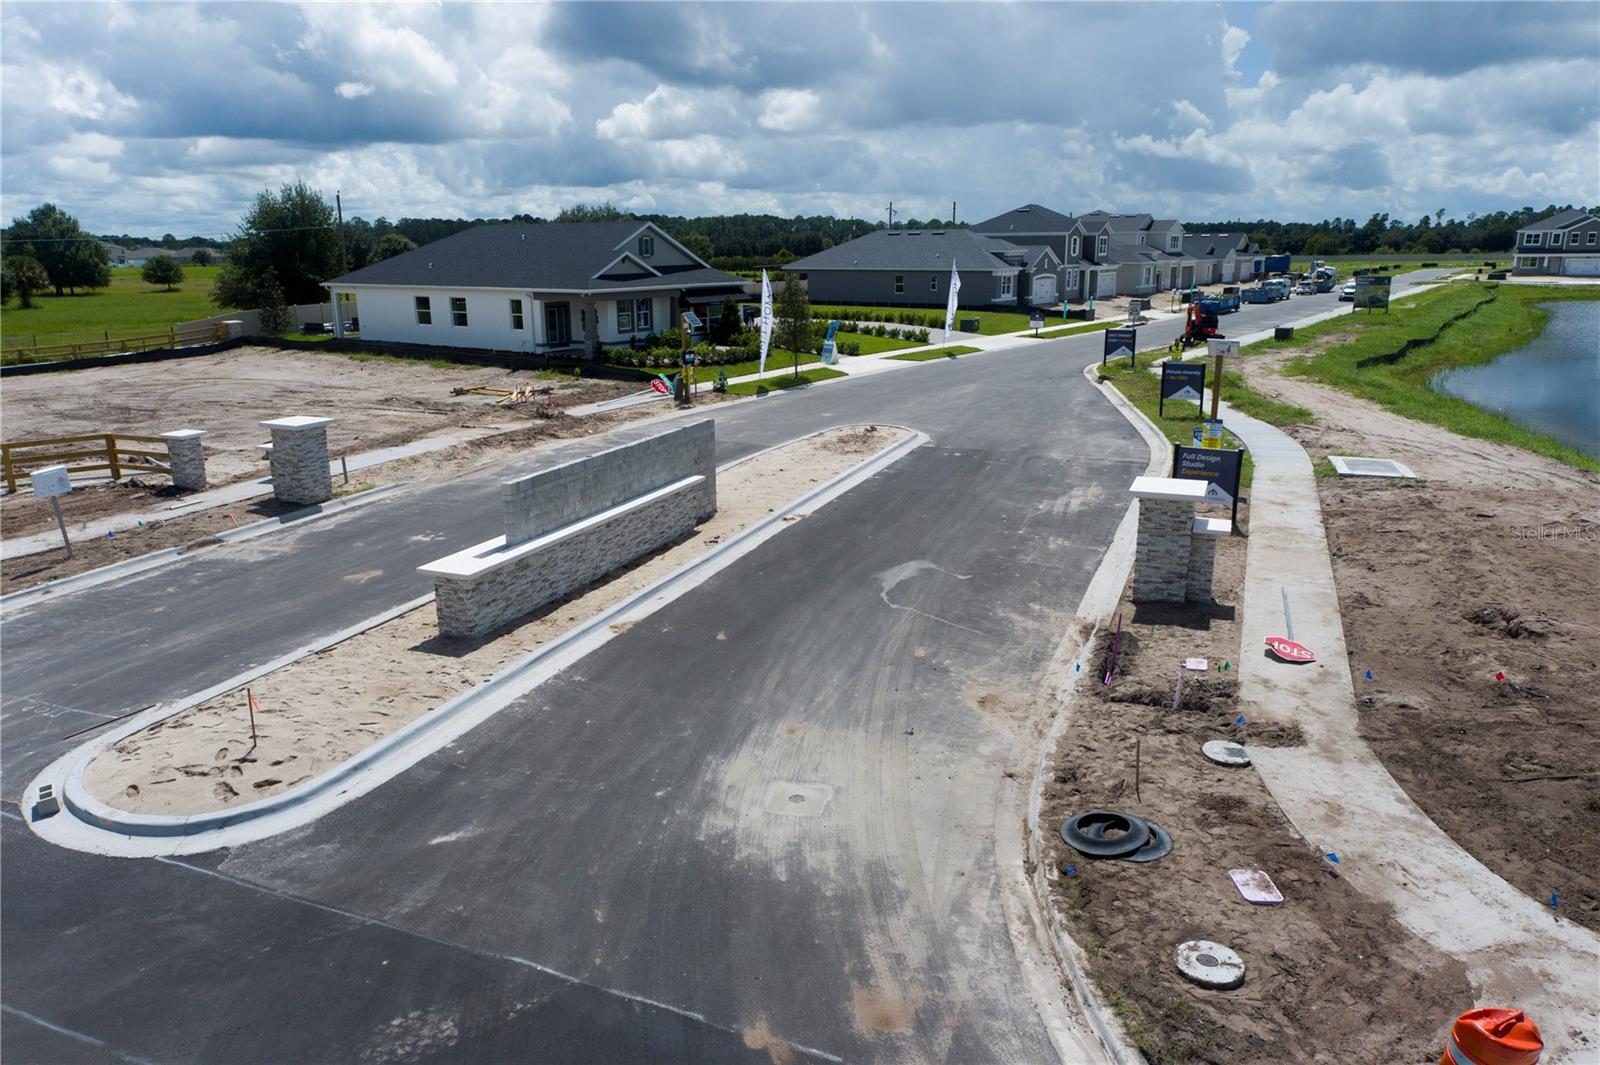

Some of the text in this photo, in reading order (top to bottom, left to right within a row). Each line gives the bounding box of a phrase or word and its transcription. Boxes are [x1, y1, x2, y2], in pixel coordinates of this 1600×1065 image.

[1182, 452, 1221, 463] Full Design
[1182, 460, 1205, 468] Studio
[1181, 468, 1219, 477] Experience
